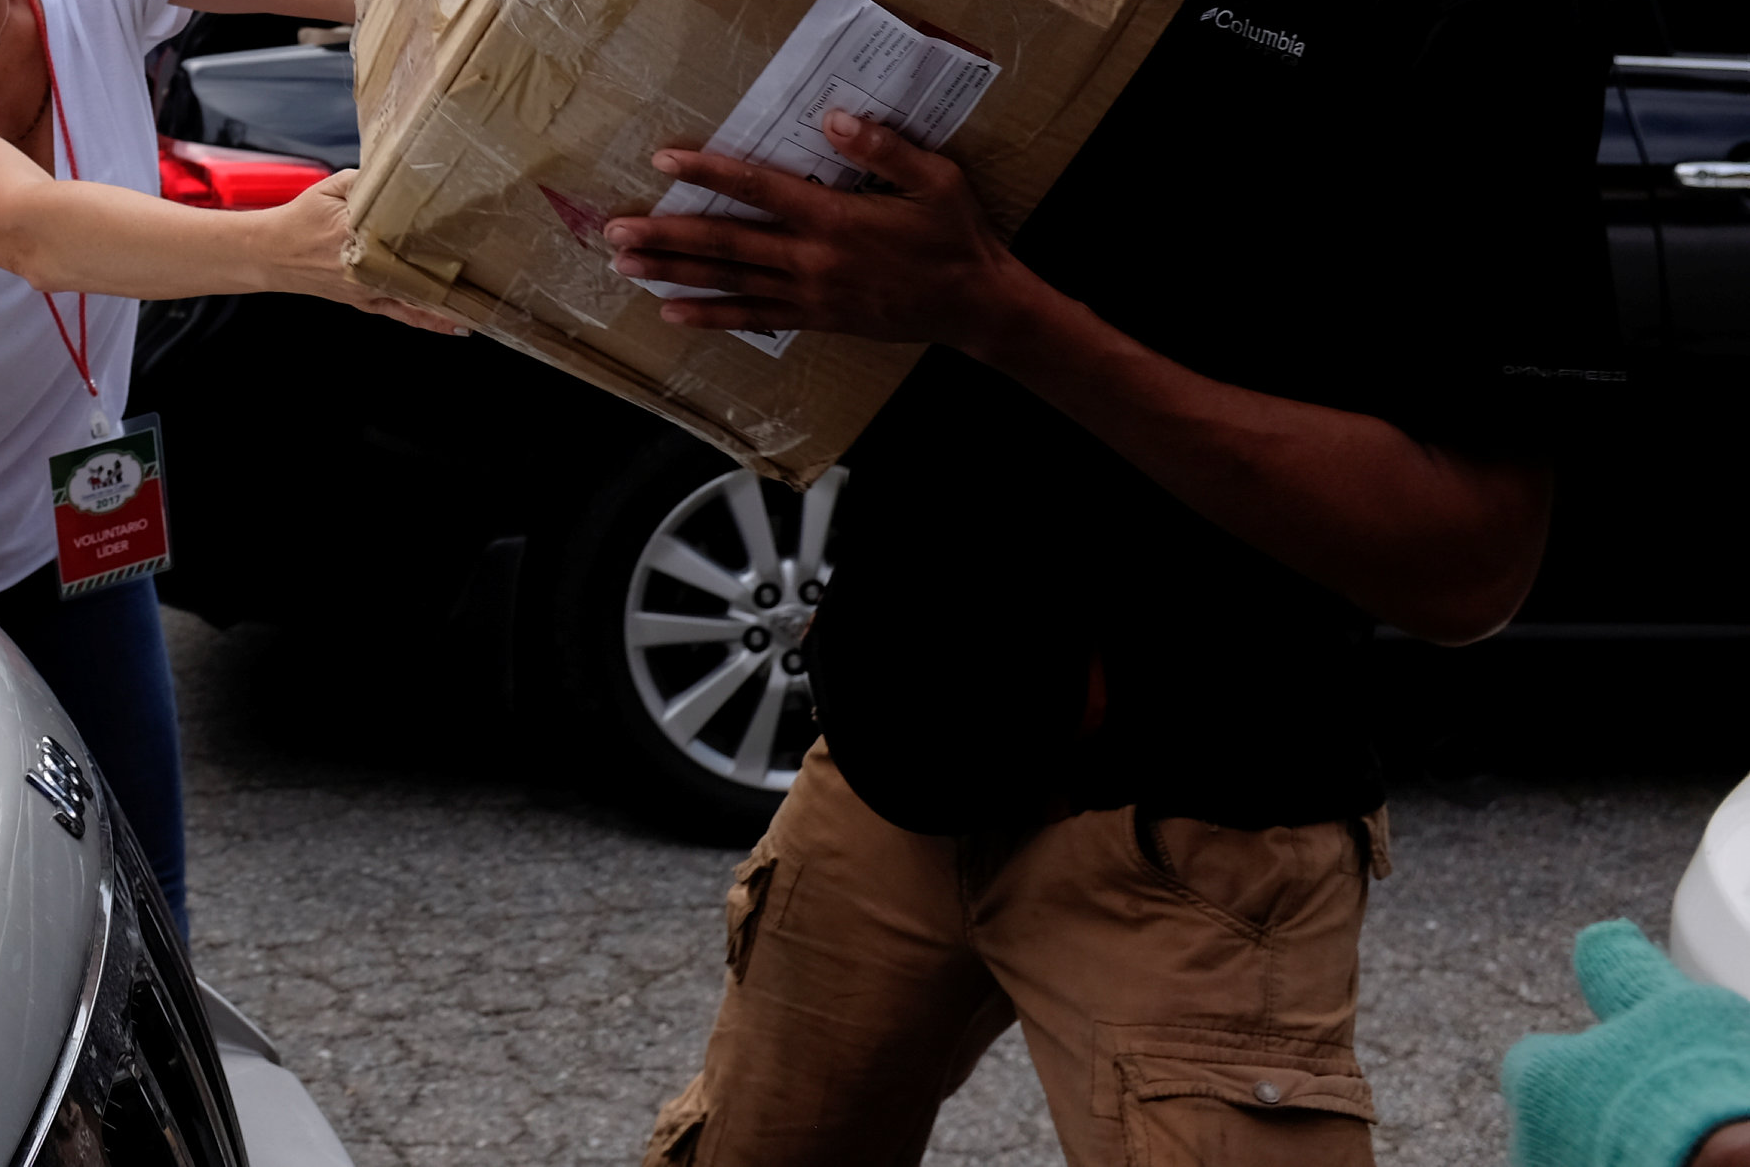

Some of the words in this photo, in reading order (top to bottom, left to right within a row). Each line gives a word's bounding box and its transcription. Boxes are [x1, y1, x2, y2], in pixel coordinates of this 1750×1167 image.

[1215, 10, 1306, 57] Columbia
[806, 82, 838, 119] Hombre
[97, 495, 120, 509] 2017
[73, 518, 148, 548] VOLUNTARIO
